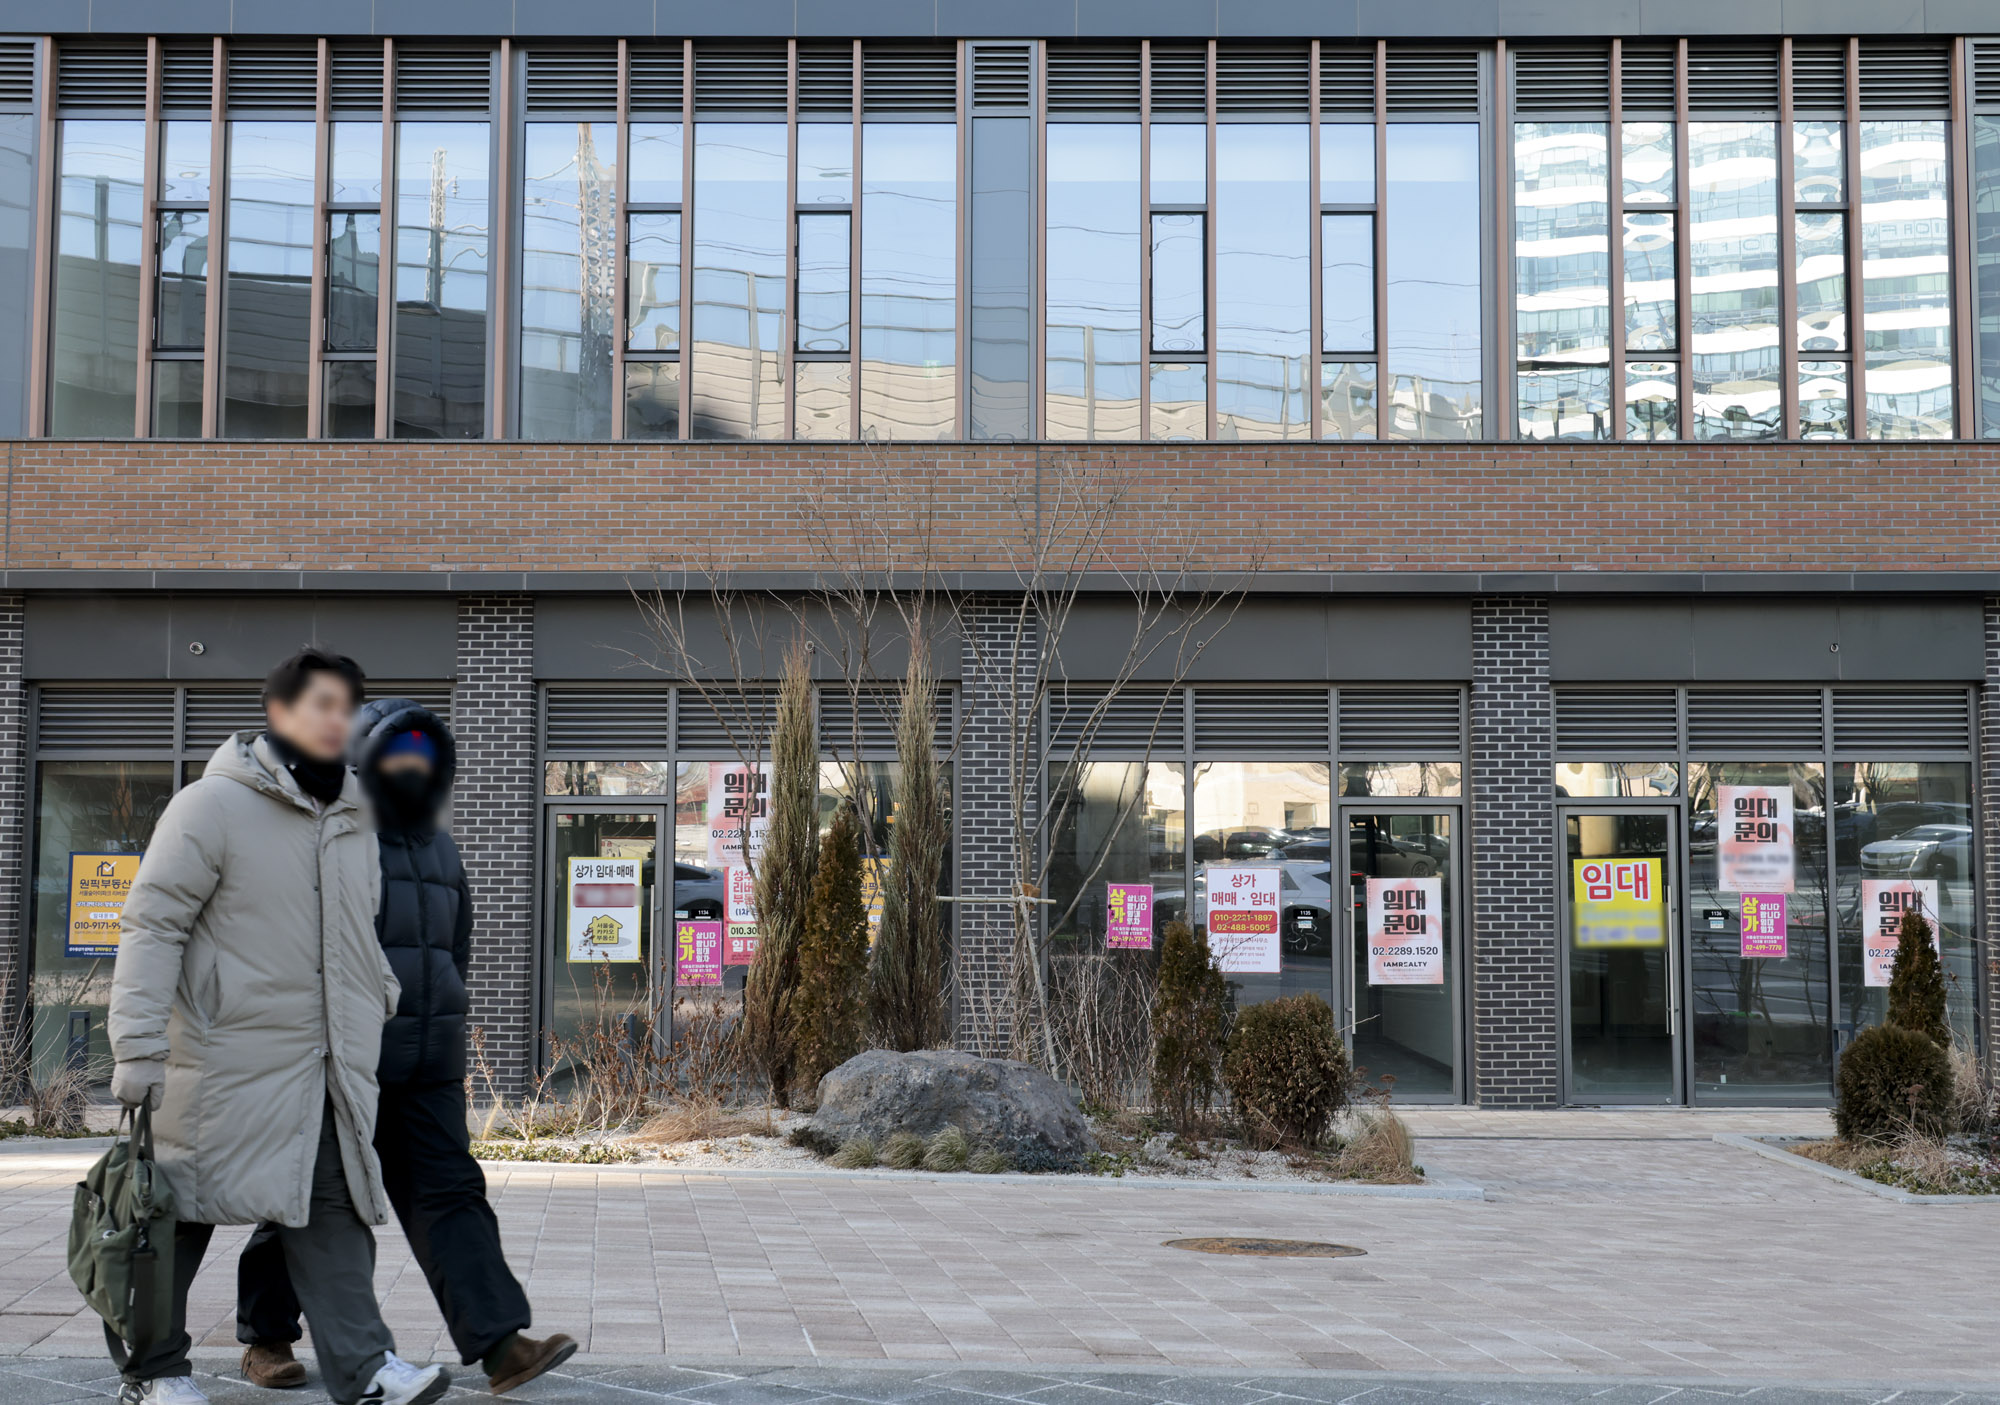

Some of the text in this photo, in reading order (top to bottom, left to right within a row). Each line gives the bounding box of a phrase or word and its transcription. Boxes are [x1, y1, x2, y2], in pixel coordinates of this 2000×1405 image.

[724, 773, 767, 793] 임대
[723, 798, 766, 818] 문의
[1734, 797, 1778, 818] 임대
[1734, 823, 1778, 843] 문의
[575, 865, 593, 878] 상가
[733, 870, 754, 881] 성수
[1231, 874, 1257, 888] 상가
[80, 879, 132, 889] 원픽부동산
[733, 882, 754, 893] 리버
[1581, 862, 1650, 901] 임대
[733, 894, 755, 905] 부동
[1110, 889, 1126, 923] 상가
[1212, 892, 1237, 906] 매매
[1251, 892, 1275, 906] 임대
[1383, 890, 1426, 910] 임대
[1879, 892, 1922, 912] 임대
[1743, 897, 1759, 932] 상가
[731, 927, 758, 935] 010.30
[1217, 924, 1270, 932] 02-488-5005
[1383, 914, 1426, 935] 문의
[1879, 917, 1903, 936] 문
[679, 926, 695, 961] 상가
[1372, 947, 1439, 955] 02.2289.1520
[1869, 949, 1899, 957] 02.22
